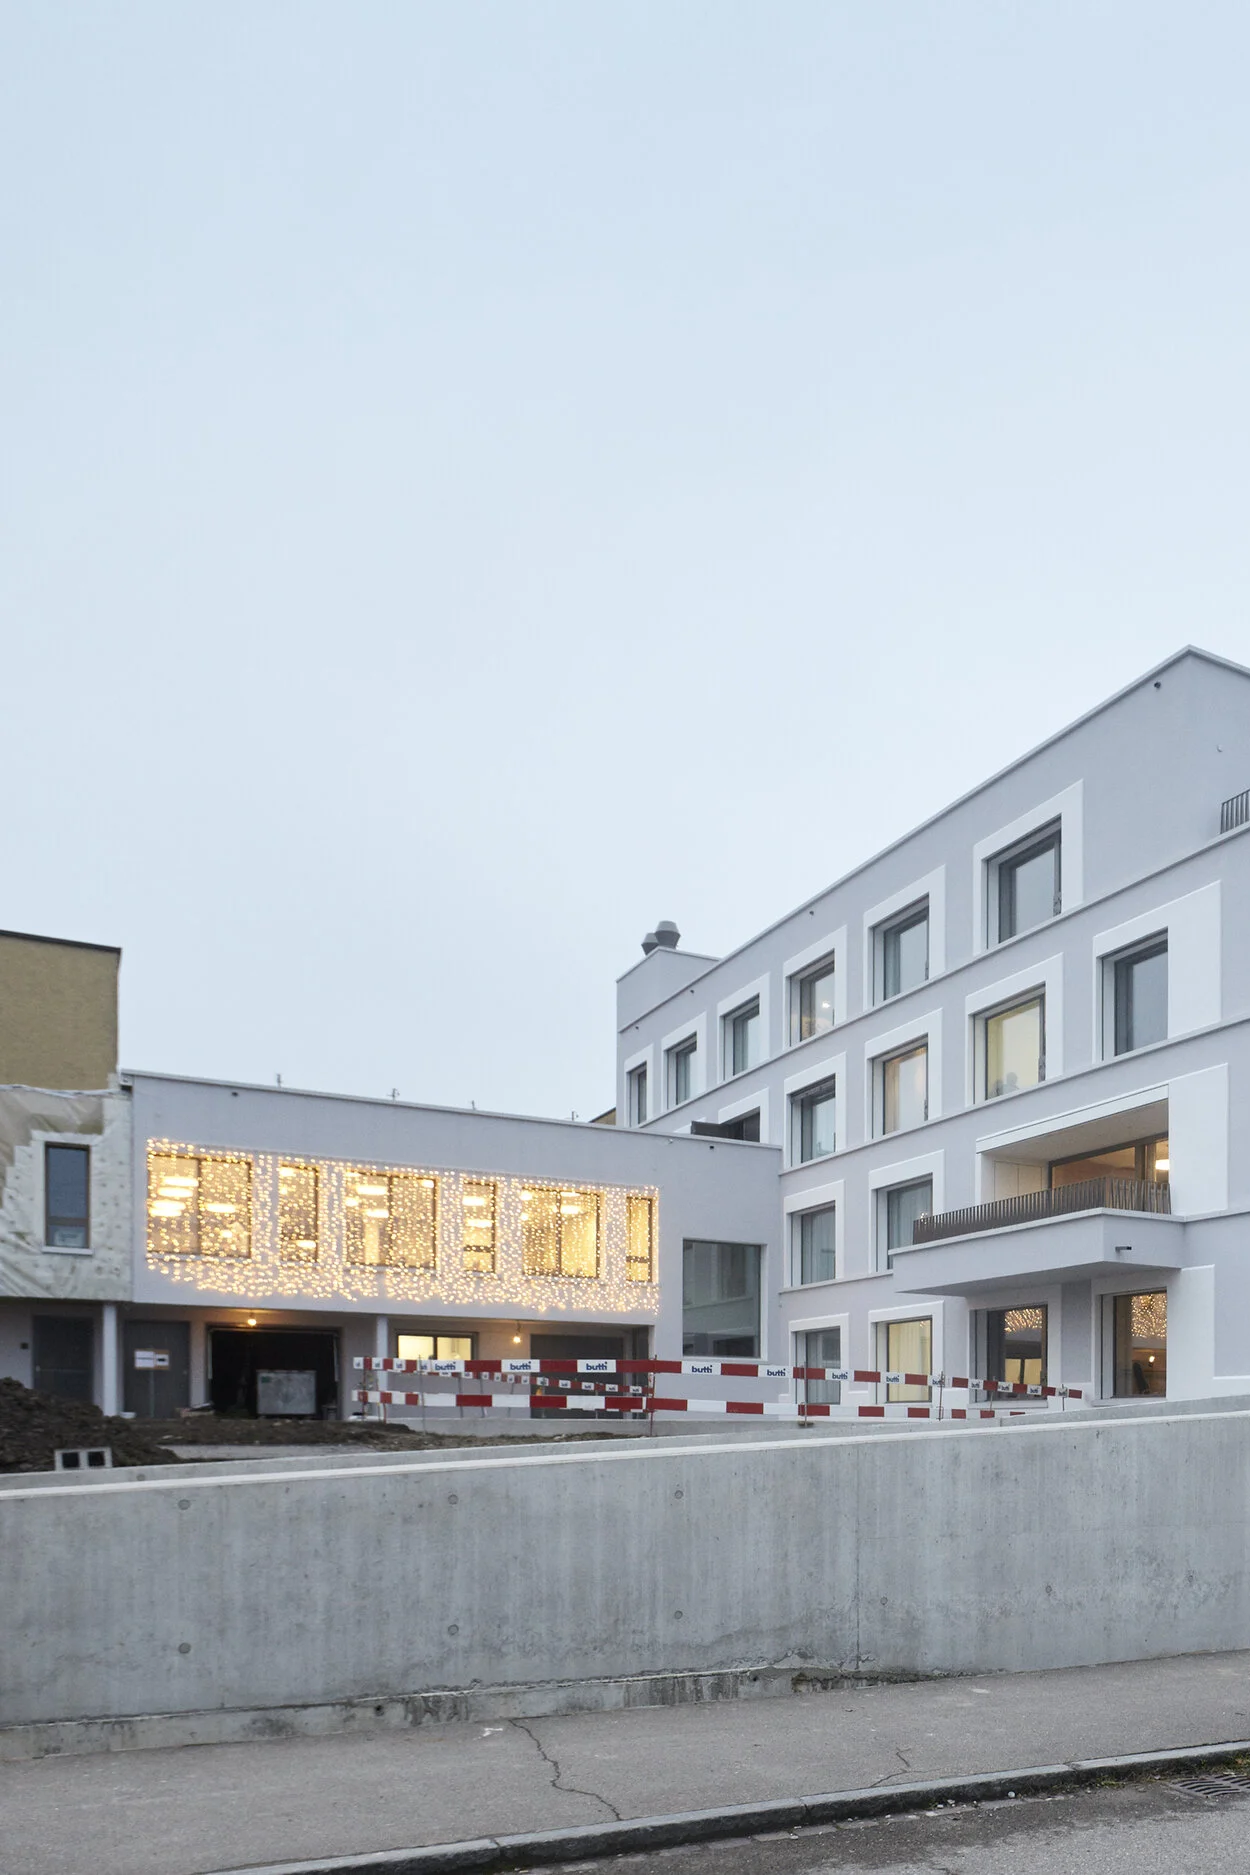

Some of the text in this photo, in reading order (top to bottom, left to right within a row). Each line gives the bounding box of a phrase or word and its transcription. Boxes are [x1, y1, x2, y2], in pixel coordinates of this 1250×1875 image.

[435, 1361, 456, 1370] butti
[510, 1361, 531, 1370] butti
[586, 1362, 607, 1370] butti
[691, 1364, 713, 1373] butti
[766, 1368, 786, 1377] butti
[832, 1371, 848, 1380] butti
[886, 1374, 900, 1383] butti
